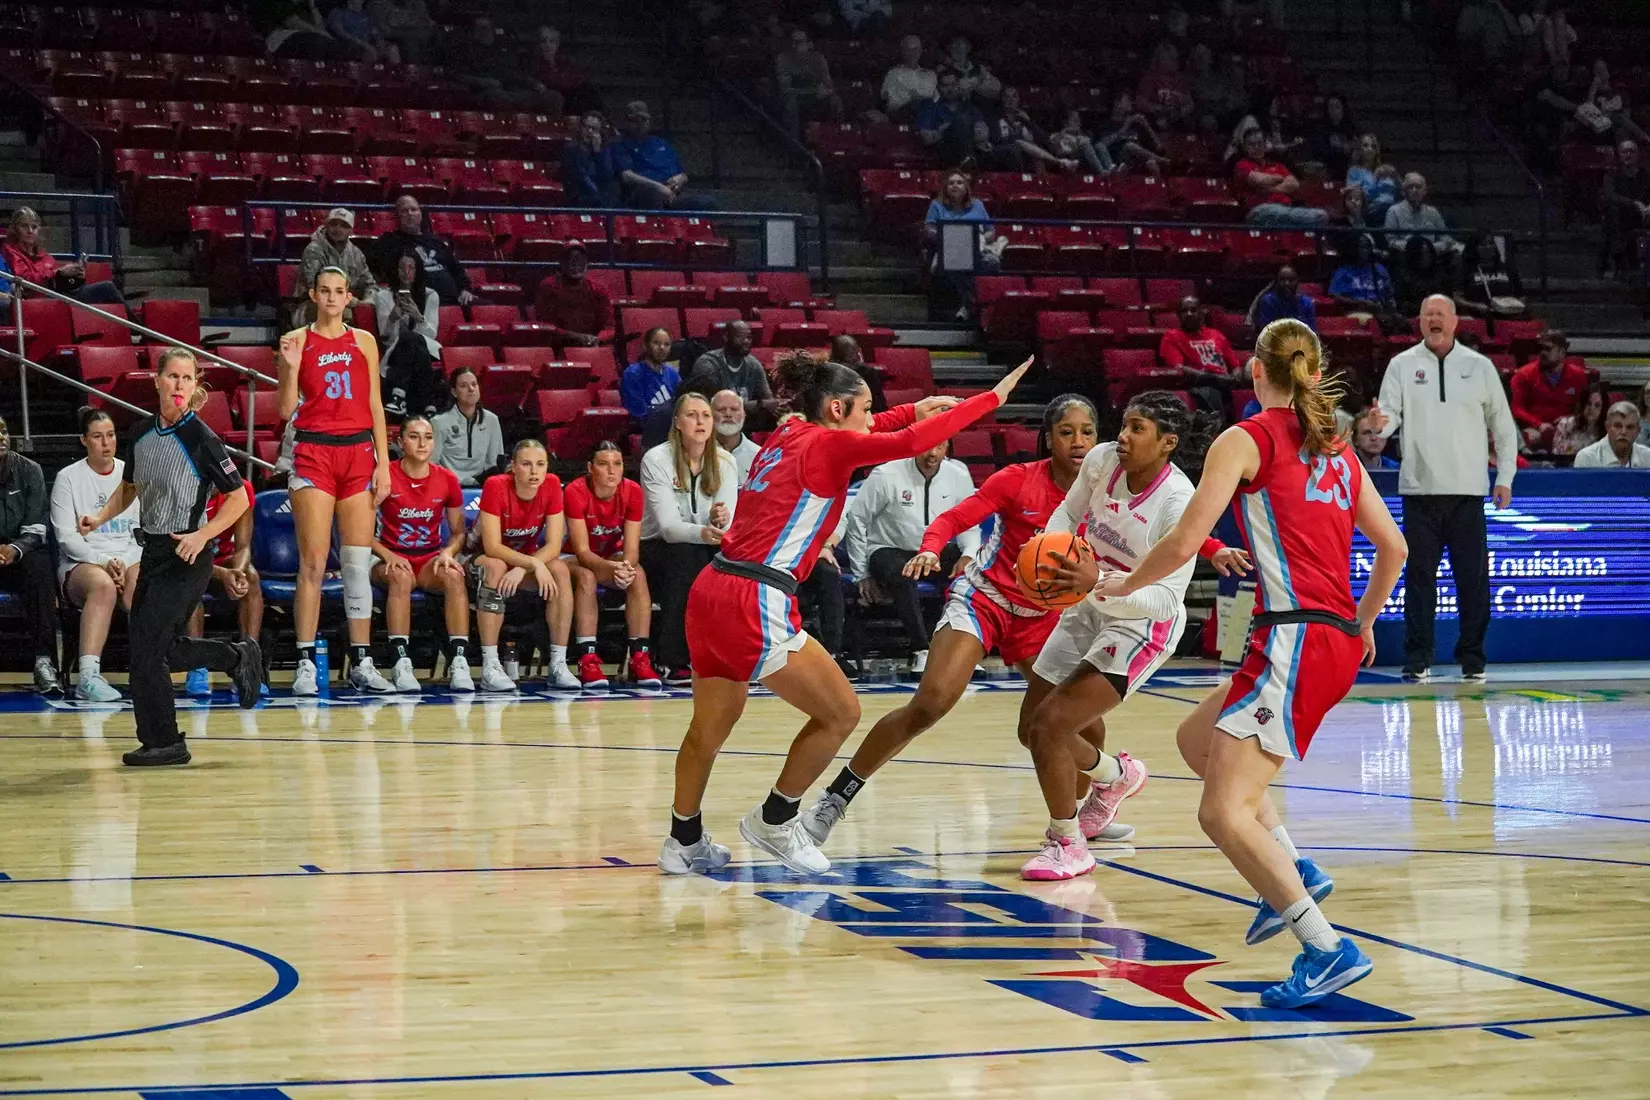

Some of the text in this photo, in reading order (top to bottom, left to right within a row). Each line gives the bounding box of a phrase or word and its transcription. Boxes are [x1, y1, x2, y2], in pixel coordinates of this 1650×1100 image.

[318, 351, 352, 367] Liberty
[325, 371, 352, 399] 31
[1298, 450, 1352, 510] 23
[397, 508, 434, 522] Liberty
[398, 523, 431, 547] 22
[1487, 551, 1607, 577] Louisiana
